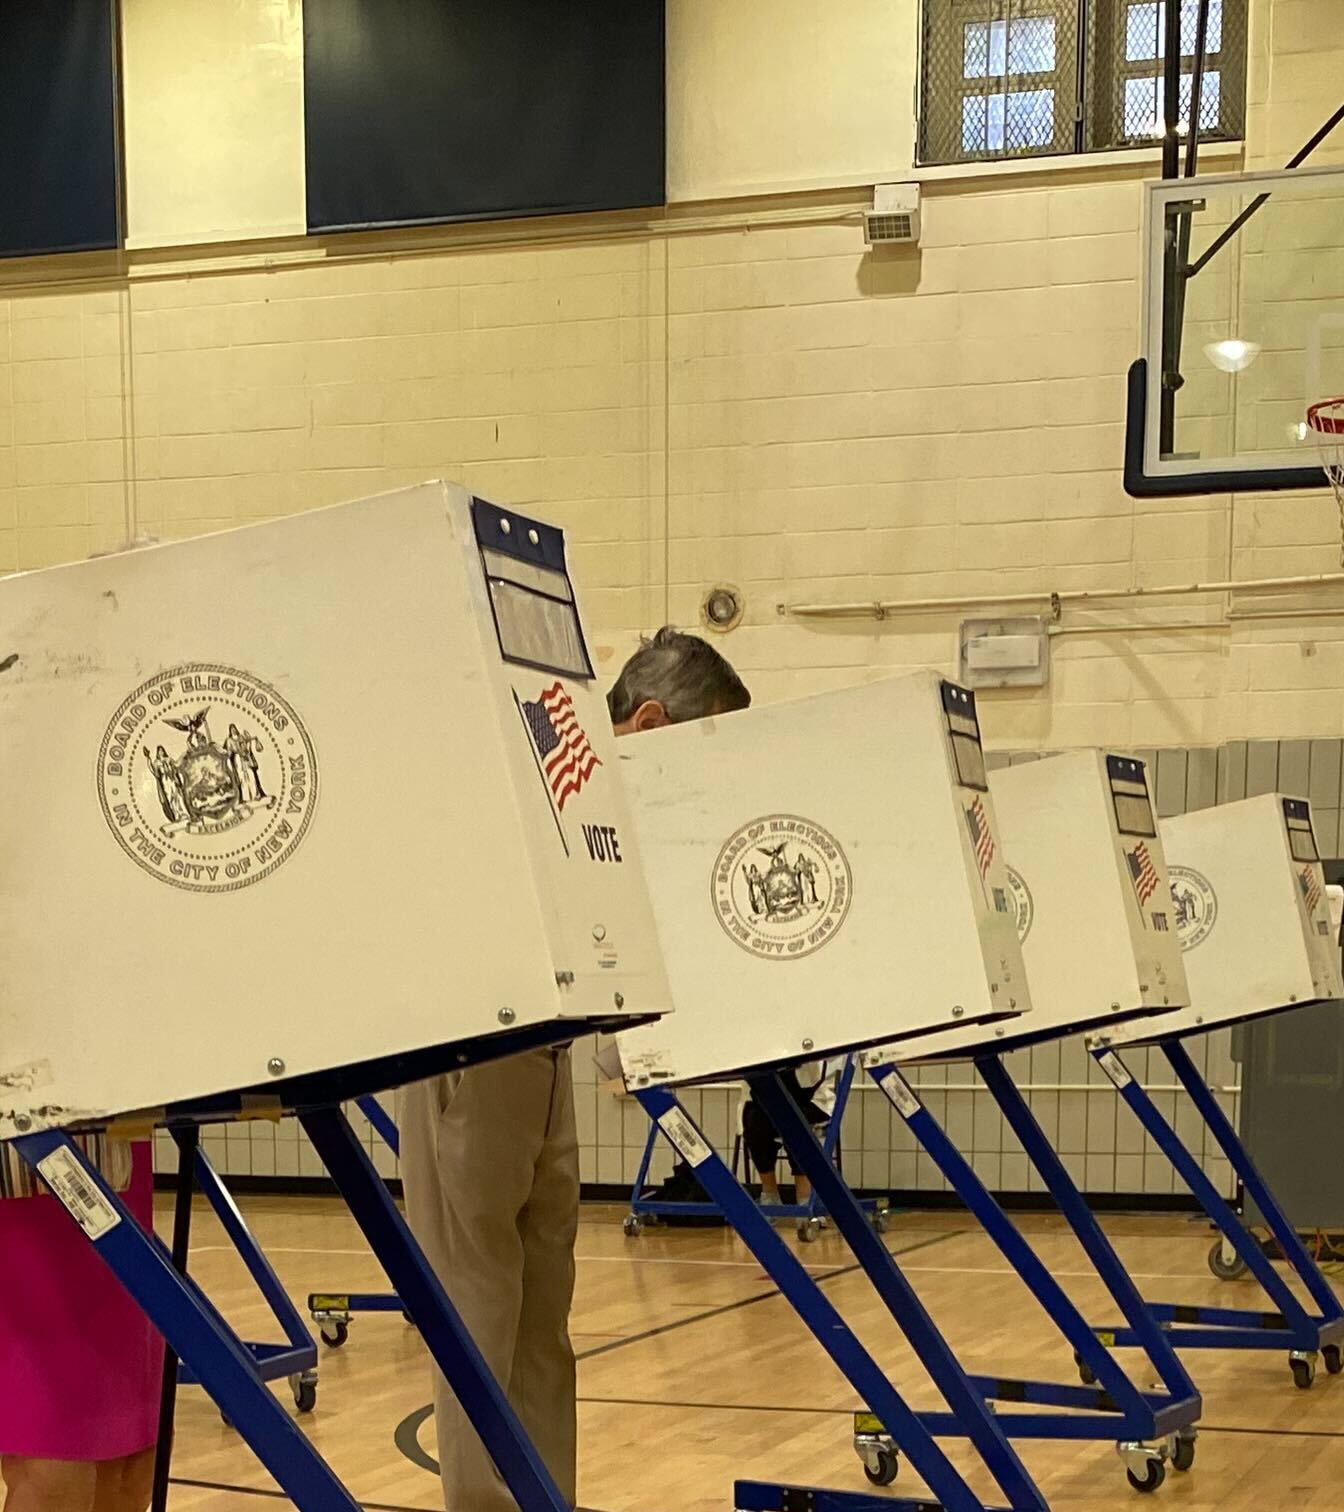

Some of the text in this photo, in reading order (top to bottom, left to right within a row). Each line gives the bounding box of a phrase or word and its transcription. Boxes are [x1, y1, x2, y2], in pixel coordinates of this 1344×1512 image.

[107, 675, 289, 777] BOARD OF ELECTIONS
[112, 753, 306, 881] IN THE CITY OF NEW YORK
[581, 824, 622, 862] VOTE
